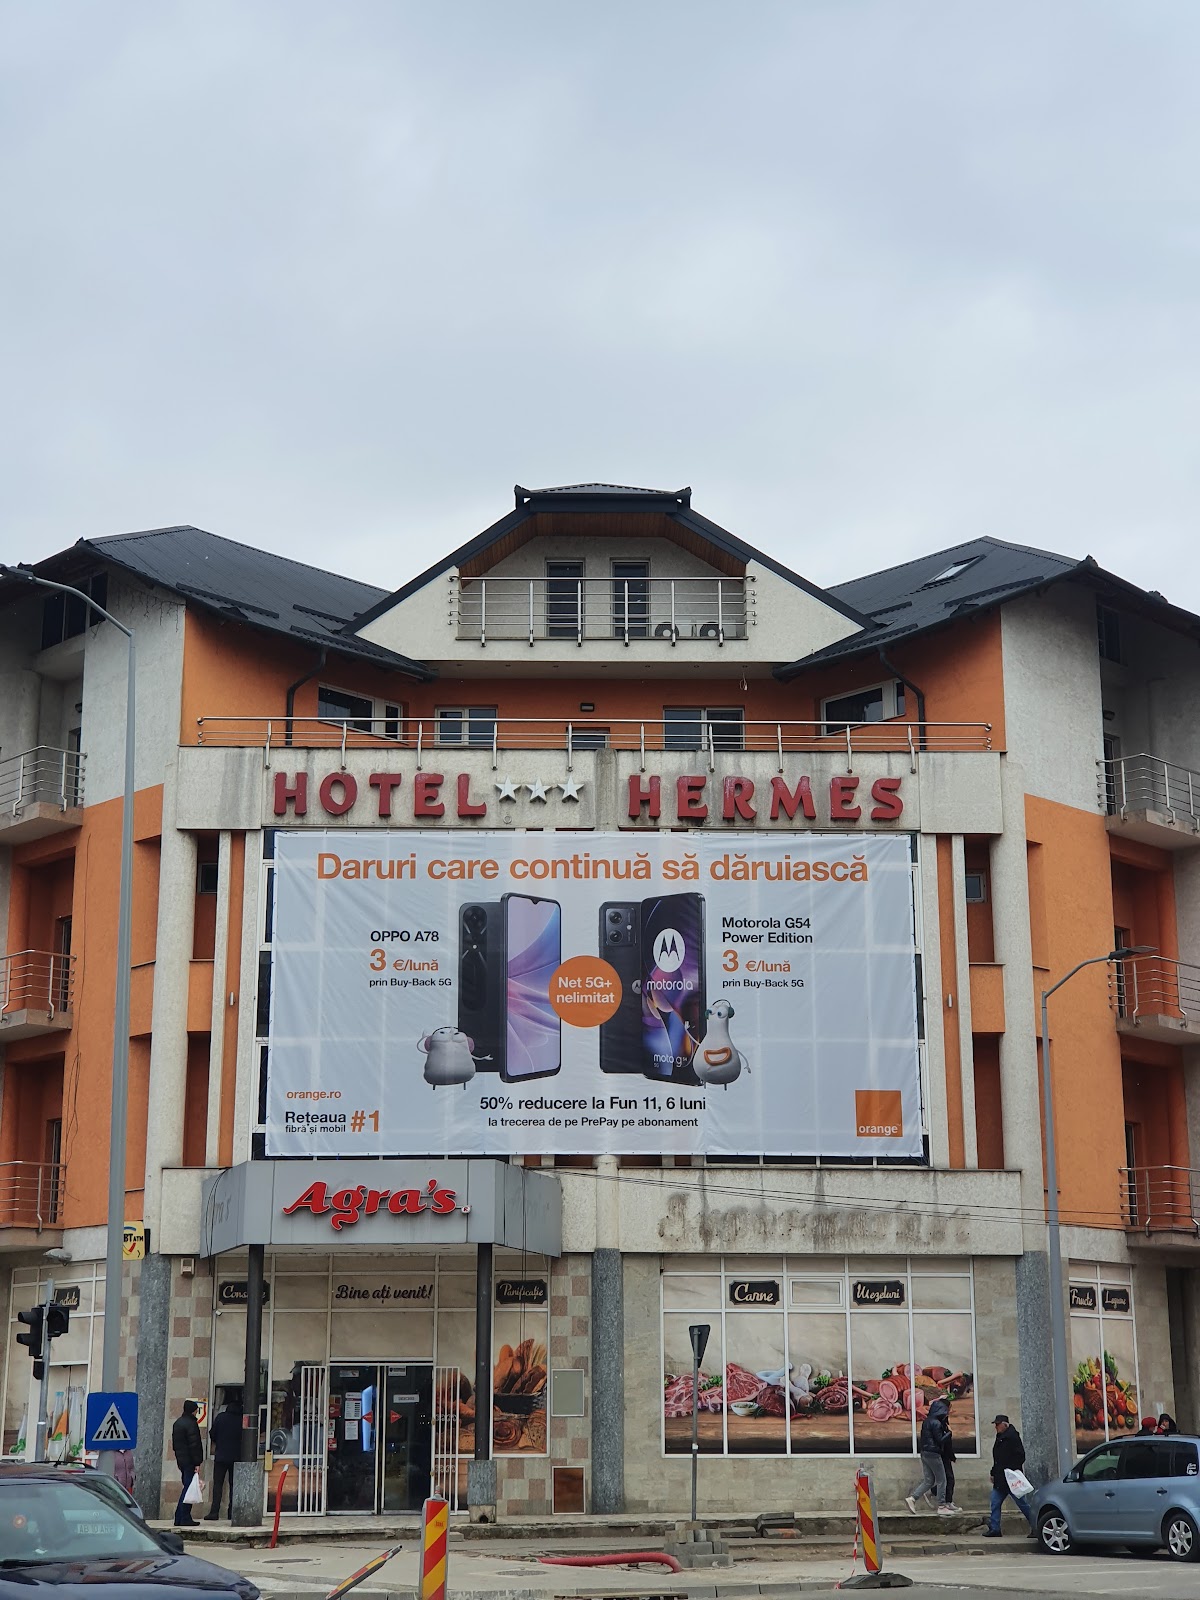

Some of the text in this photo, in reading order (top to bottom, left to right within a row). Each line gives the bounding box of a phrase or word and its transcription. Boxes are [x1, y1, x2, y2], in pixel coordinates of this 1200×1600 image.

[273, 772, 904, 820] HOTEL HERMES
[317, 853, 869, 882] Daruri care continuă să dăruiască
[722, 917, 811, 928] Motorola G54
[370, 930, 439, 942] OPPO A78
[722, 932, 813, 943] Power Edition
[370, 948, 439, 971] 3 €/lună
[722, 949, 791, 972] 3 €/lună
[369, 978, 452, 988] prin Buy-Back 5G
[558, 976, 612, 988] Net 5G+
[646, 978, 694, 990] motorola
[722, 979, 804, 989] prin Buy-Back 5G
[556, 991, 615, 1003] nelimitat
[653, 1053, 674, 1063] moto
[286, 1090, 342, 1101] orange.ro
[479, 1096, 706, 1112] 50% reducere la Fun 11, 6 luni
[285, 1110, 379, 1132] Rețeaua #1
[488, 1117, 699, 1129] la trecerea de pe PrePay pe abonament
[285, 1125, 306, 1133] fibră
[320, 1125, 346, 1133] mobil
[859, 1125, 898, 1136] orange
[282, 1179, 457, 1231] Agra's
[222, 1285, 266, 1299] Conse
[335, 1284, 434, 1304] Bine ați venit!
[734, 1283, 774, 1301] Carne
[1070, 1288, 1093, 1306] Fructe
